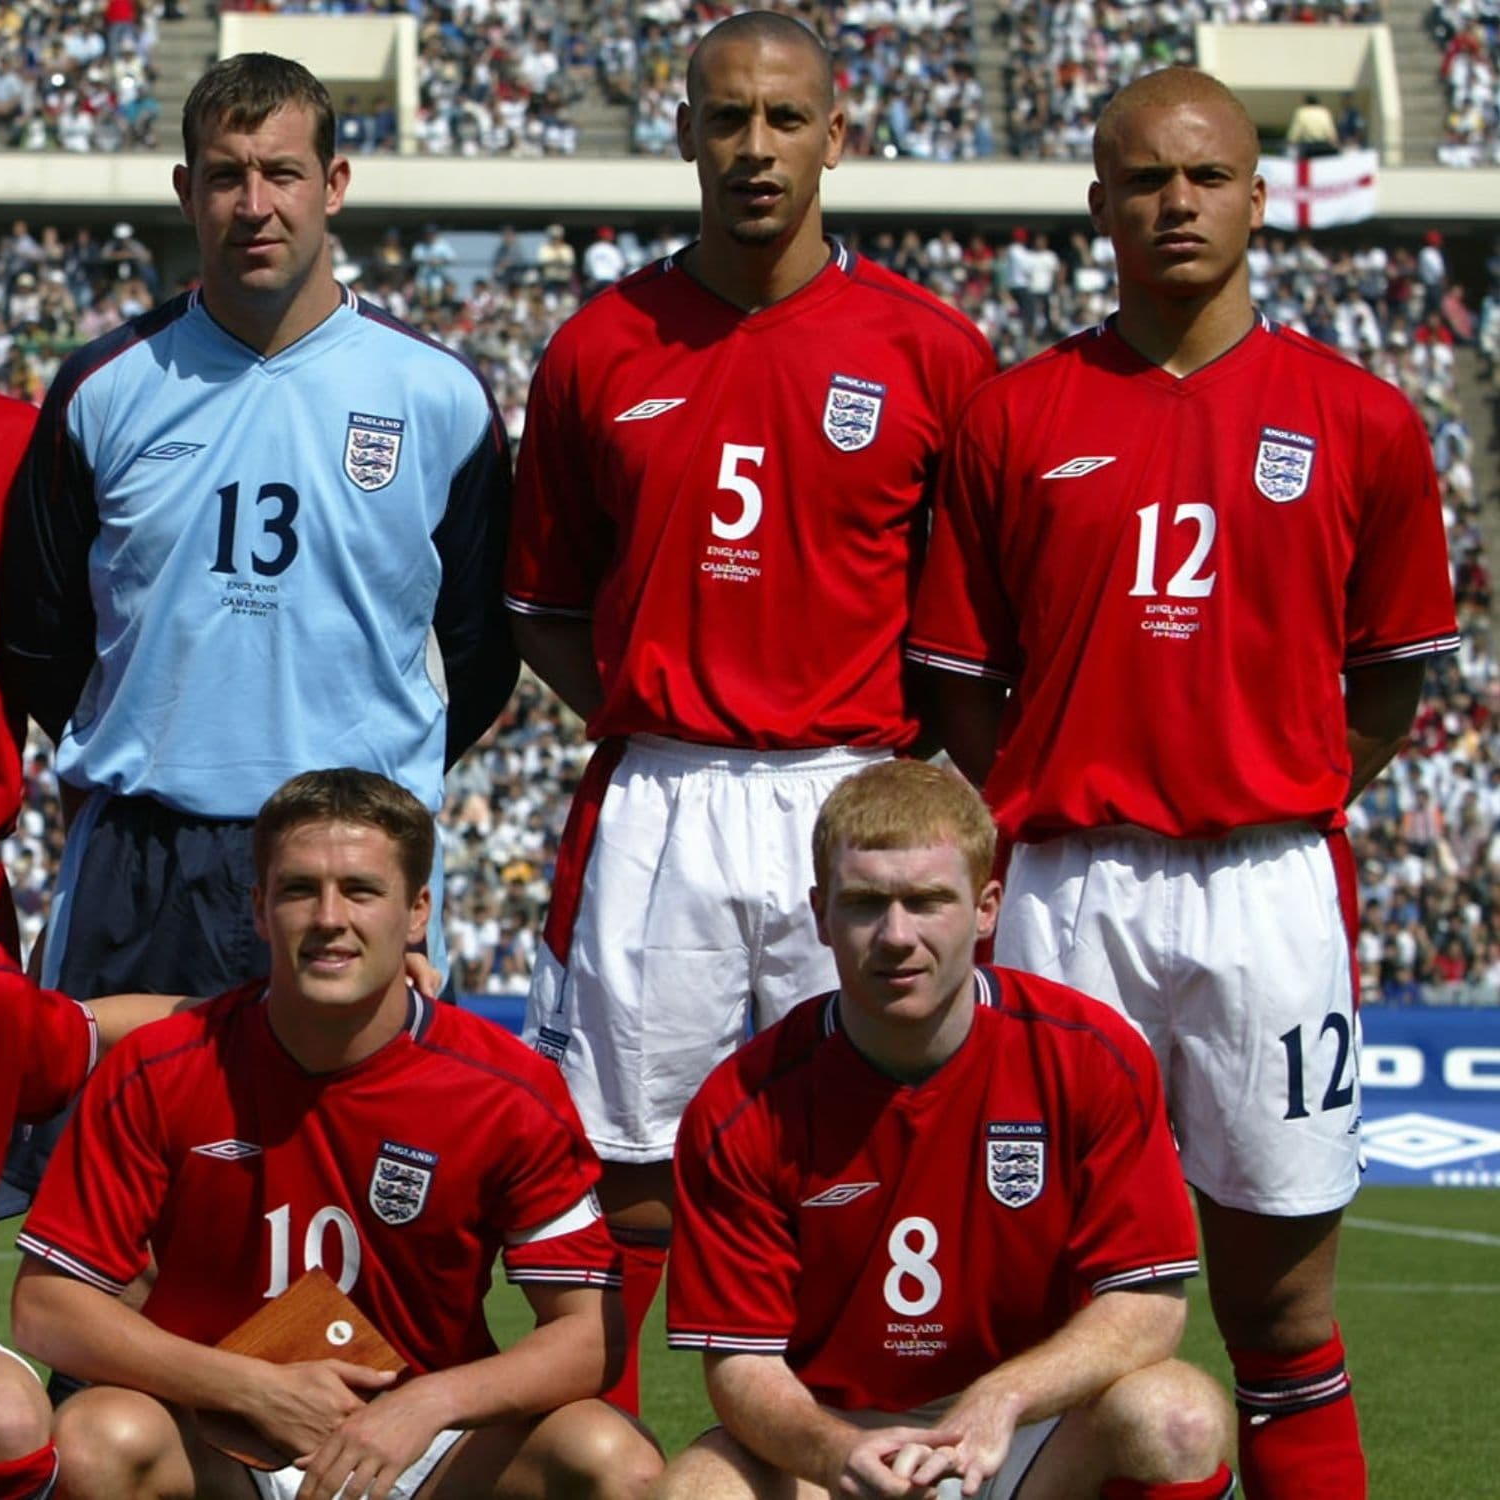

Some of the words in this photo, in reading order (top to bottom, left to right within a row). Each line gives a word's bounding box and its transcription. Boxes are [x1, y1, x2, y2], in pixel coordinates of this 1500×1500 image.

[834, 374, 883, 392] ENGLAND
[352, 415, 401, 430] ENGLAND
[1265, 427, 1314, 446] ENGLAND
[710, 442, 765, 541] 5
[209, 480, 300, 577] 13
[706, 545, 760, 560] ENGLAND
[1128, 502, 1217, 598] 12
[700, 562, 762, 577] CAMEROON
[226, 580, 278, 594] ENGLAND
[220, 596, 279, 611] CAMEROON
[1145, 603, 1199, 616] ENGLAND
[1279, 1012, 1354, 1121] 12
[990, 1125, 1042, 1134] ENGLAND
[383, 1142, 434, 1164] ENGLAND
[263, 1203, 361, 1299] 10
[883, 1216, 942, 1317] 8
[886, 1323, 943, 1334] ENGLAND
